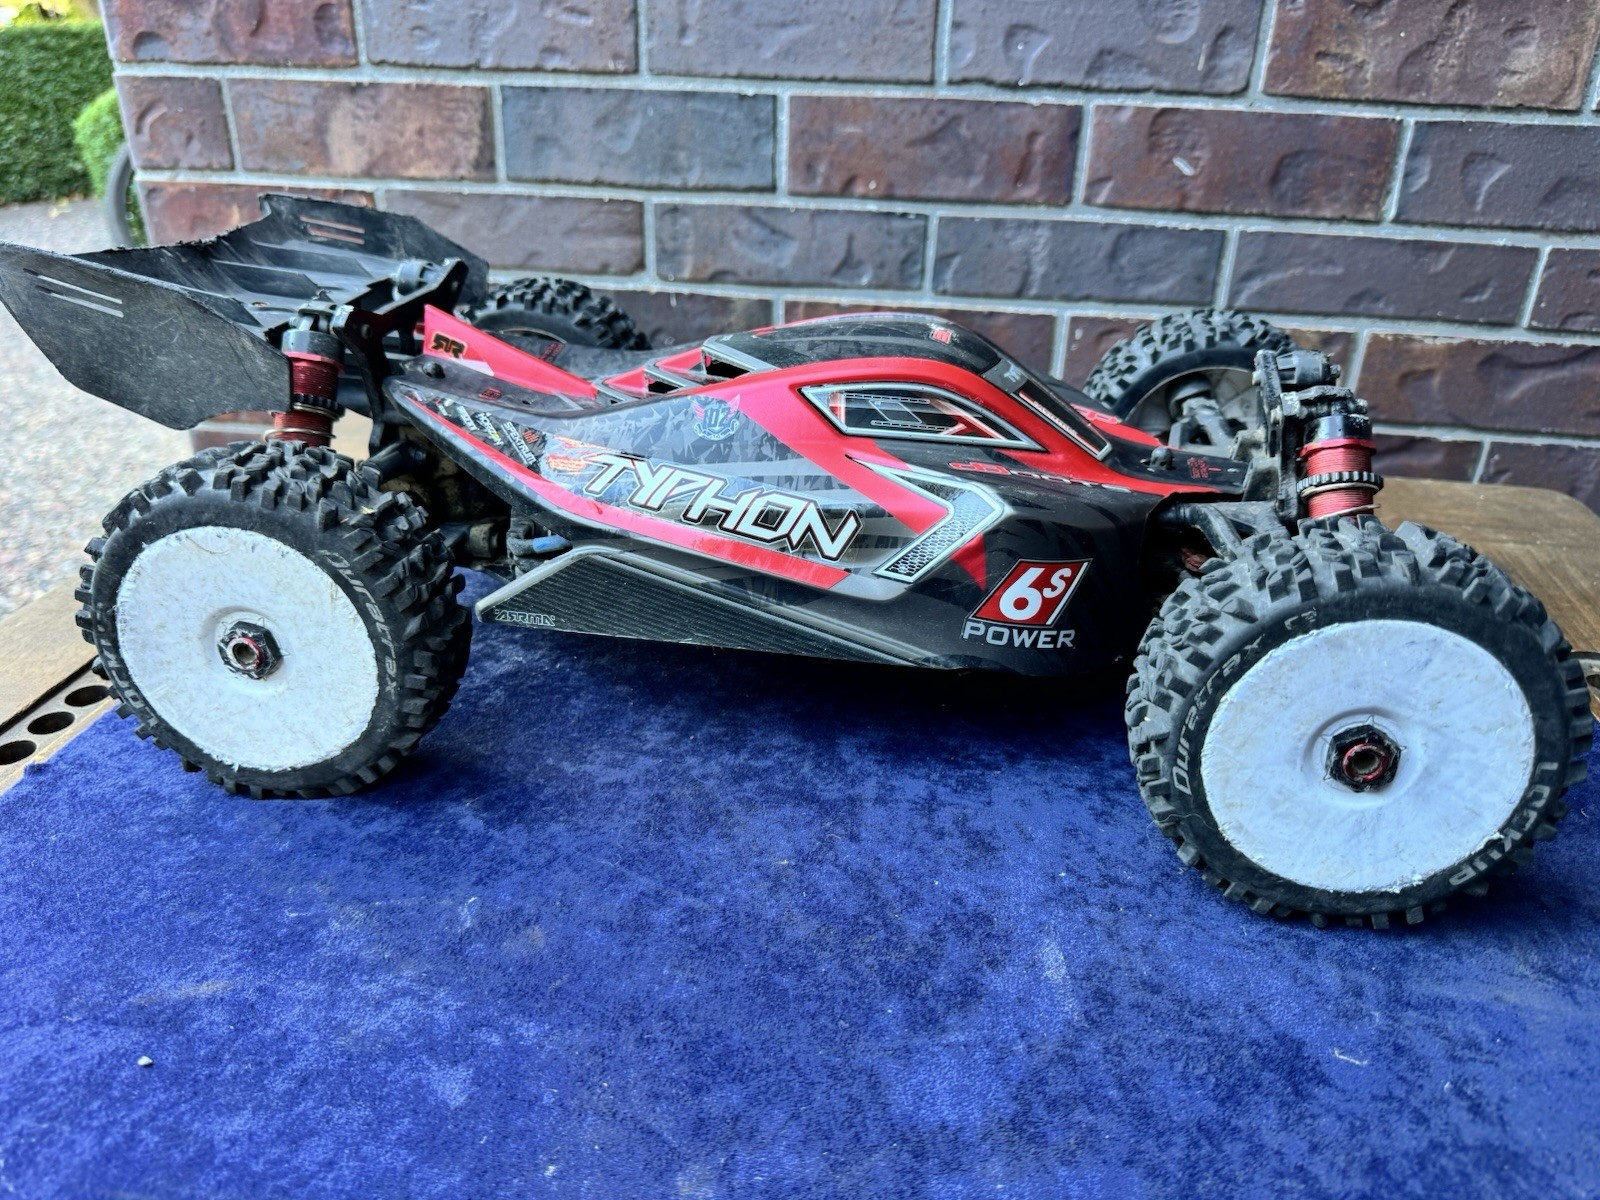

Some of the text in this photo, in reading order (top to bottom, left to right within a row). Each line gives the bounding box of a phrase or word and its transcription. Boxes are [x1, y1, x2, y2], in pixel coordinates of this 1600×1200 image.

[503, 420, 537, 466] SPEKTRUM
[582, 453, 863, 562] TYPHON
[495, 609, 556, 627] ARRMA
[999, 567, 1072, 621] 6S
[962, 621, 1076, 649] POWER
[1448, 761, 1559, 886] LOCKUP
